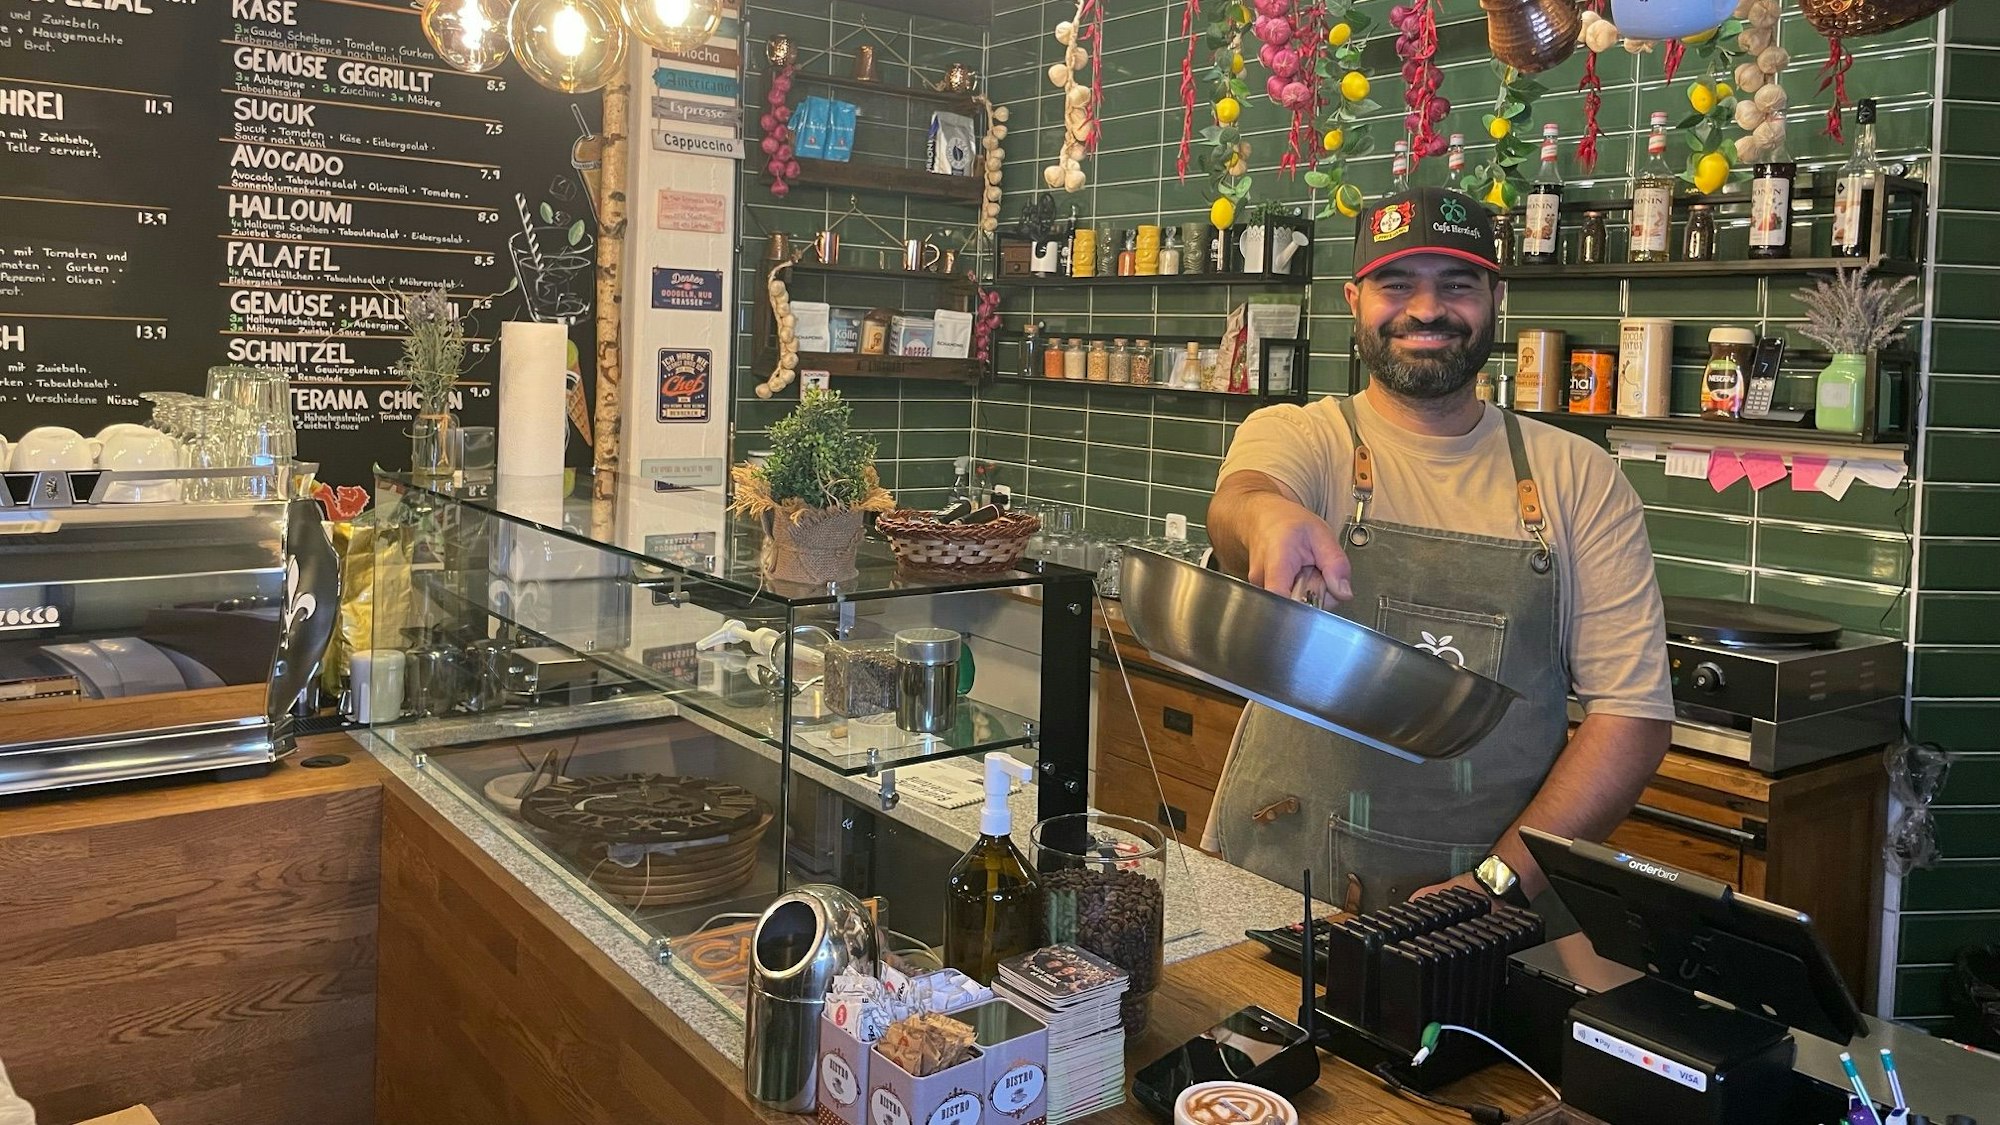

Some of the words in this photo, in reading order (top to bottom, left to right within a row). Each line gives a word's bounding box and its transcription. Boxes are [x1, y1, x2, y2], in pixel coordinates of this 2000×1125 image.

[10, 11, 31, 21] und
[42, 14, 100, 30] Zwiebeln
[33, 27, 123, 45] Hausgemachte
[287, 30, 332, 46] Scheiben
[344, 37, 387, 53] Tomaten
[399, 46, 434, 60] Gurken
[677, 48, 720, 63] Mocha
[234, 47, 327, 80] GEMÜSE
[338, 62, 433, 93] GEGRILLT
[486, 79, 506, 92] 8.5
[253, 72, 305, 90] Aubergine
[340, 85, 380, 98] Zucchini
[408, 94, 441, 108] Möhre
[145, 100, 173, 115] 11.9
[670, 101, 725, 119] Espresso
[234, 122, 267, 135] Sucuk
[278, 127, 325, 140] Tomaten
[339, 133, 362, 145] Käse
[372, 137, 429, 152] Eisbergsalat
[485, 123, 503, 135] 7.5
[10, 129, 28, 140] mit
[39, 132, 94, 148] Zwiebeln,
[234, 131, 265, 144] Sauce
[270, 136, 297, 147] nach
[664, 133, 733, 152] Cappuccino
[6, 141, 41, 154] Teller
[50, 145, 101, 159] serviert.
[230, 144, 344, 176] AVOCADO
[480, 169, 501, 181] 7.9
[231, 169, 274, 183] Avocado
[285, 174, 357, 191] Taboulehsalat
[368, 182, 409, 195] Olivenöl
[420, 187, 461, 200] Tomaten
[137, 211, 167, 226] 13.9
[229, 194, 352, 225] HALLOUMI
[477, 212, 499, 224] 8.0
[231, 229, 270, 239] Zwiebel
[275, 232, 303, 240] Sauce
[243, 220, 285, 232] Halloumi
[289, 222, 329, 235] Scheiben
[338, 228, 400, 240] Taboulehsalat
[411, 231, 463, 244] Eisbergsalat
[1433, 222, 1451, 233] Cafe
[14, 247, 33, 256] mit
[42, 247, 97, 260] Tomaten
[106, 251, 127, 262] und
[226, 241, 340, 272] FALAFEL
[474, 255, 495, 267] 8.5
[66, 262, 109, 273] Gurken
[0, 272, 45, 284] Peperoni
[66, 275, 102, 285] Oliven
[324, 273, 386, 286] Taboulehsalat
[230, 290, 334, 317] GEMÜSE
[246, 314, 328, 328] Halloumischeiben
[353, 319, 400, 332] Aubergine
[246, 323, 280, 334] Möhre
[136, 325, 167, 340] 13.9
[834, 328, 858, 341] Kölln
[227, 338, 355, 364] SCHNITZEL
[472, 343, 490, 353] 8.5
[8, 362, 26, 372] mit
[315, 364, 380, 377] Gewürzgurken
[1761, 362, 1769, 373] 7
[35, 379, 110, 389] Taboulehsalat
[470, 387, 490, 398] 9.0
[661, 373, 707, 397] Chef
[26, 393, 98, 405] Verschiedene
[107, 394, 139, 407] Nüsse
[296, 421, 331, 430] Zwiebel
[334, 423, 360, 431] Sauce
[1628, 860, 1679, 882] orderbird
[830, 1058, 848, 1080] BISTRO
[1679, 1070, 1699, 1085] VISA
[1006, 1070, 1033, 1089] BISTRO
[880, 1094, 901, 1117] BISTRO
[941, 1099, 970, 1121] BISTRO
